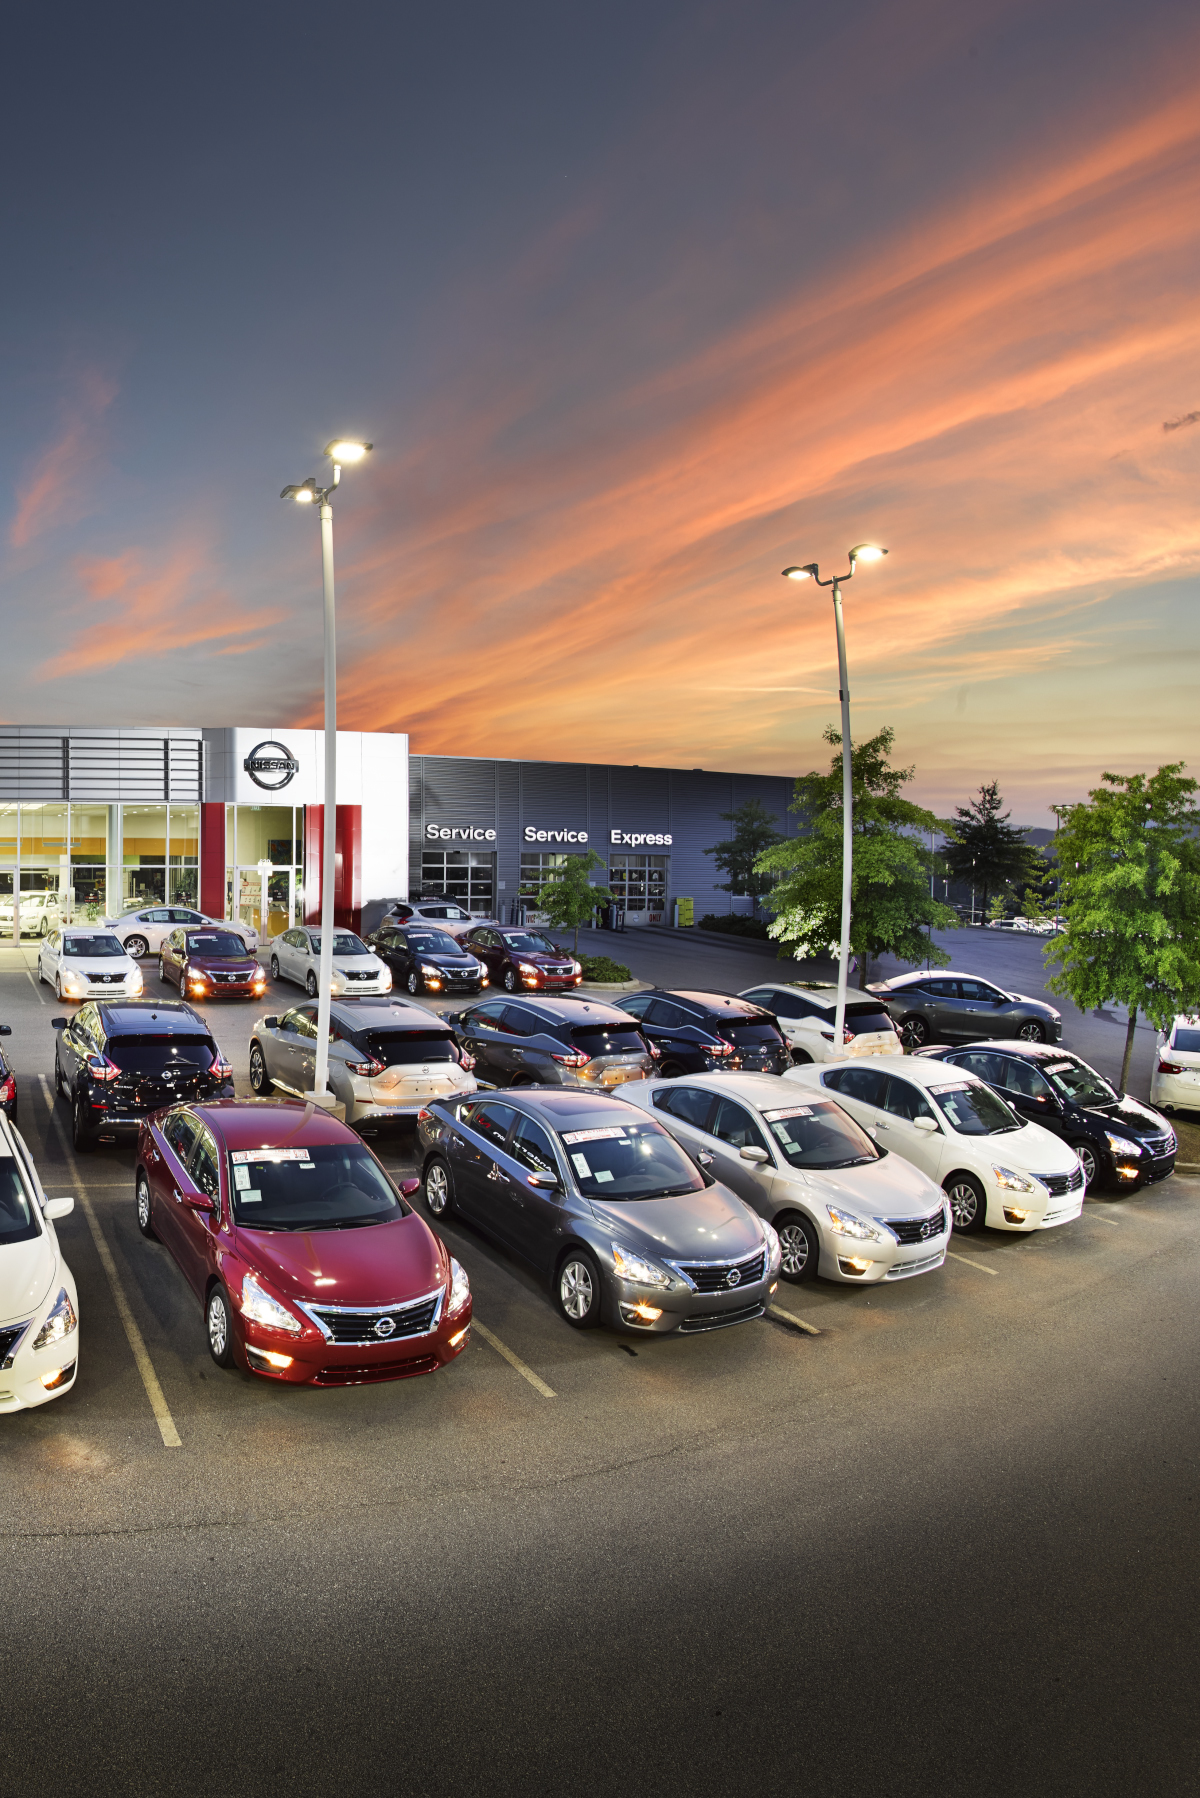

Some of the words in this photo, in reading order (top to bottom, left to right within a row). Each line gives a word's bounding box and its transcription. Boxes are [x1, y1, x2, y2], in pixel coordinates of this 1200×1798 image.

[249, 760, 295, 771] NISSAN
[426, 824, 496, 840] Service
[524, 826, 588, 843] Service
[610, 829, 673, 848] Express
